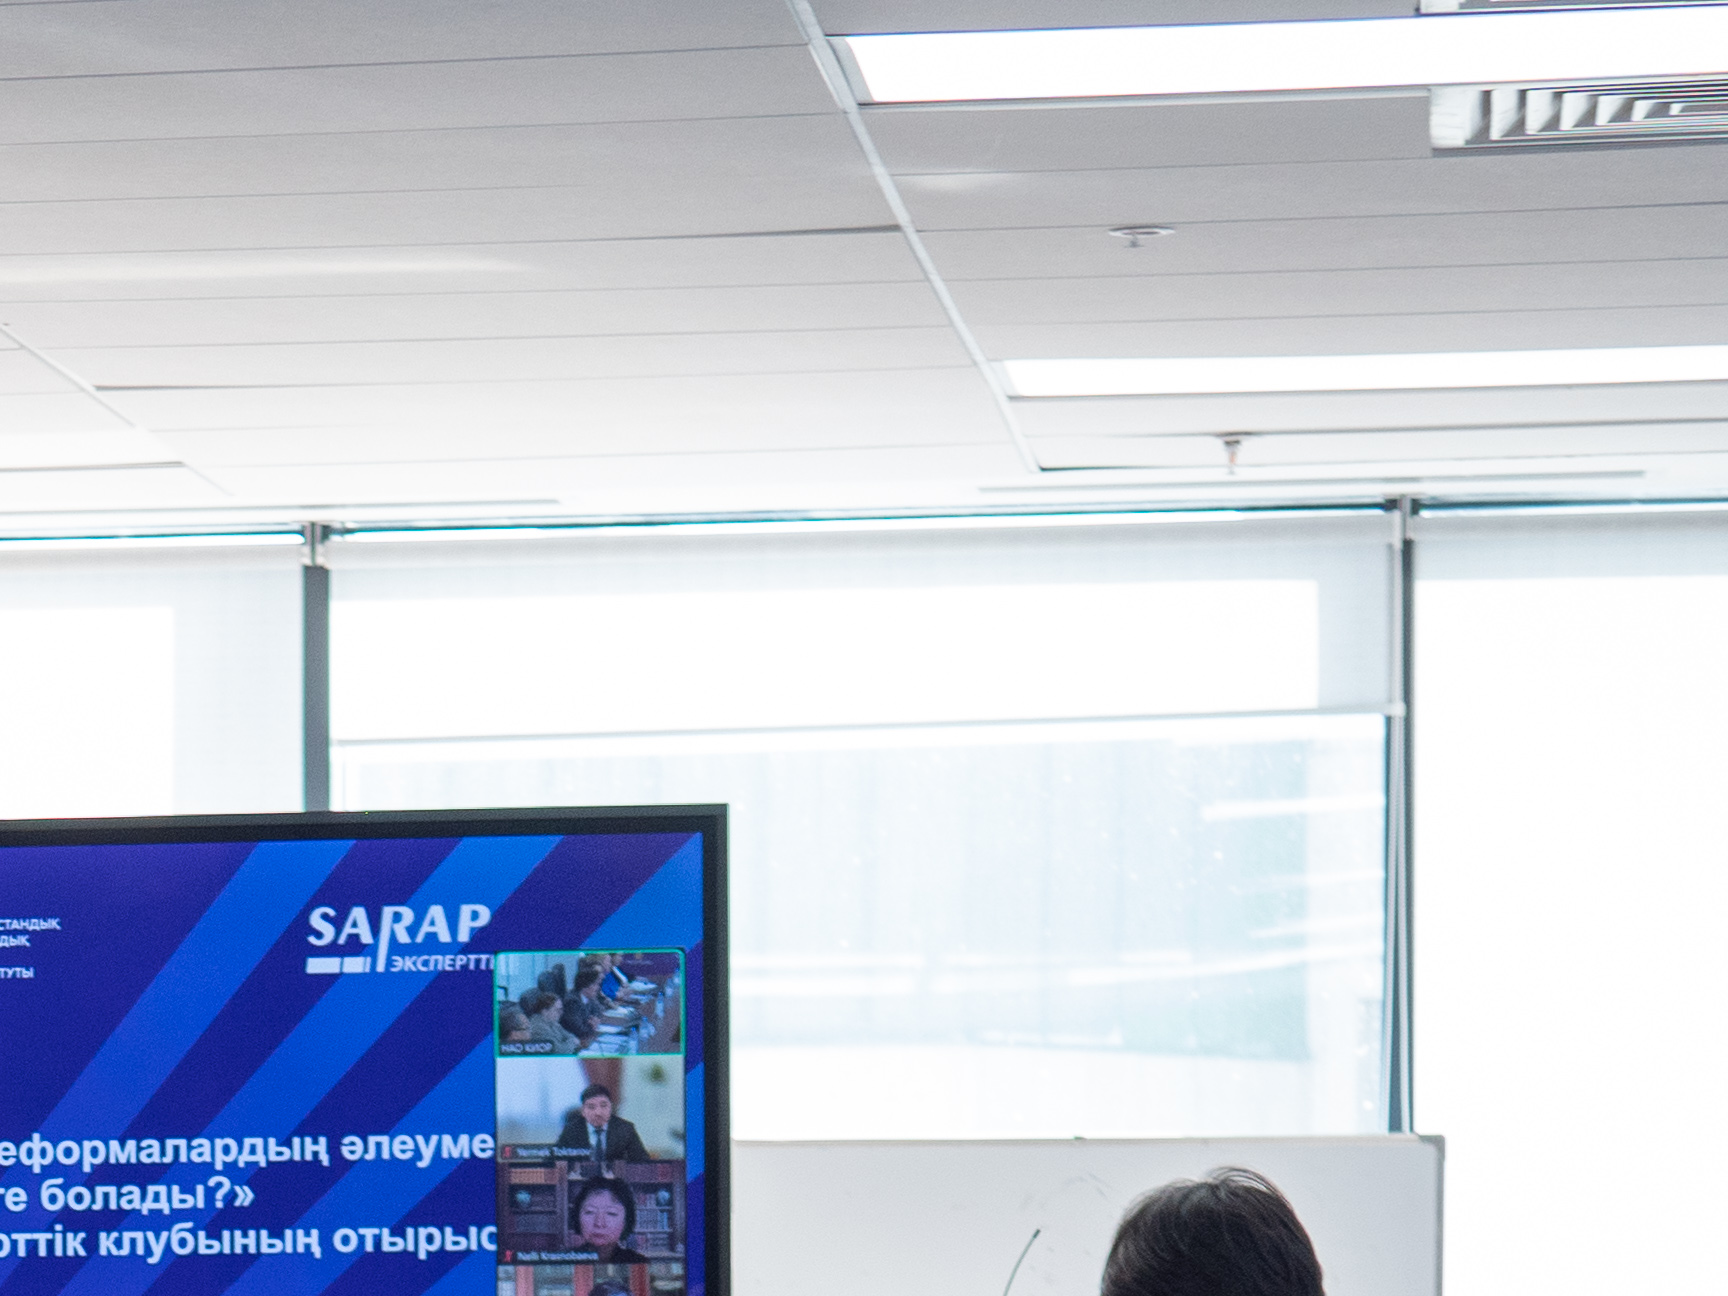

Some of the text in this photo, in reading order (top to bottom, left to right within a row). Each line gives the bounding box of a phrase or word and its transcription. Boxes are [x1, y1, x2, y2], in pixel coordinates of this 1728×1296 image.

[307, 904, 492, 972] SARAP
[340, 1134, 496, 1169] әлеуме
[41, 1175, 255, 1217] болады?»
[98, 1222, 322, 1264] клубының
